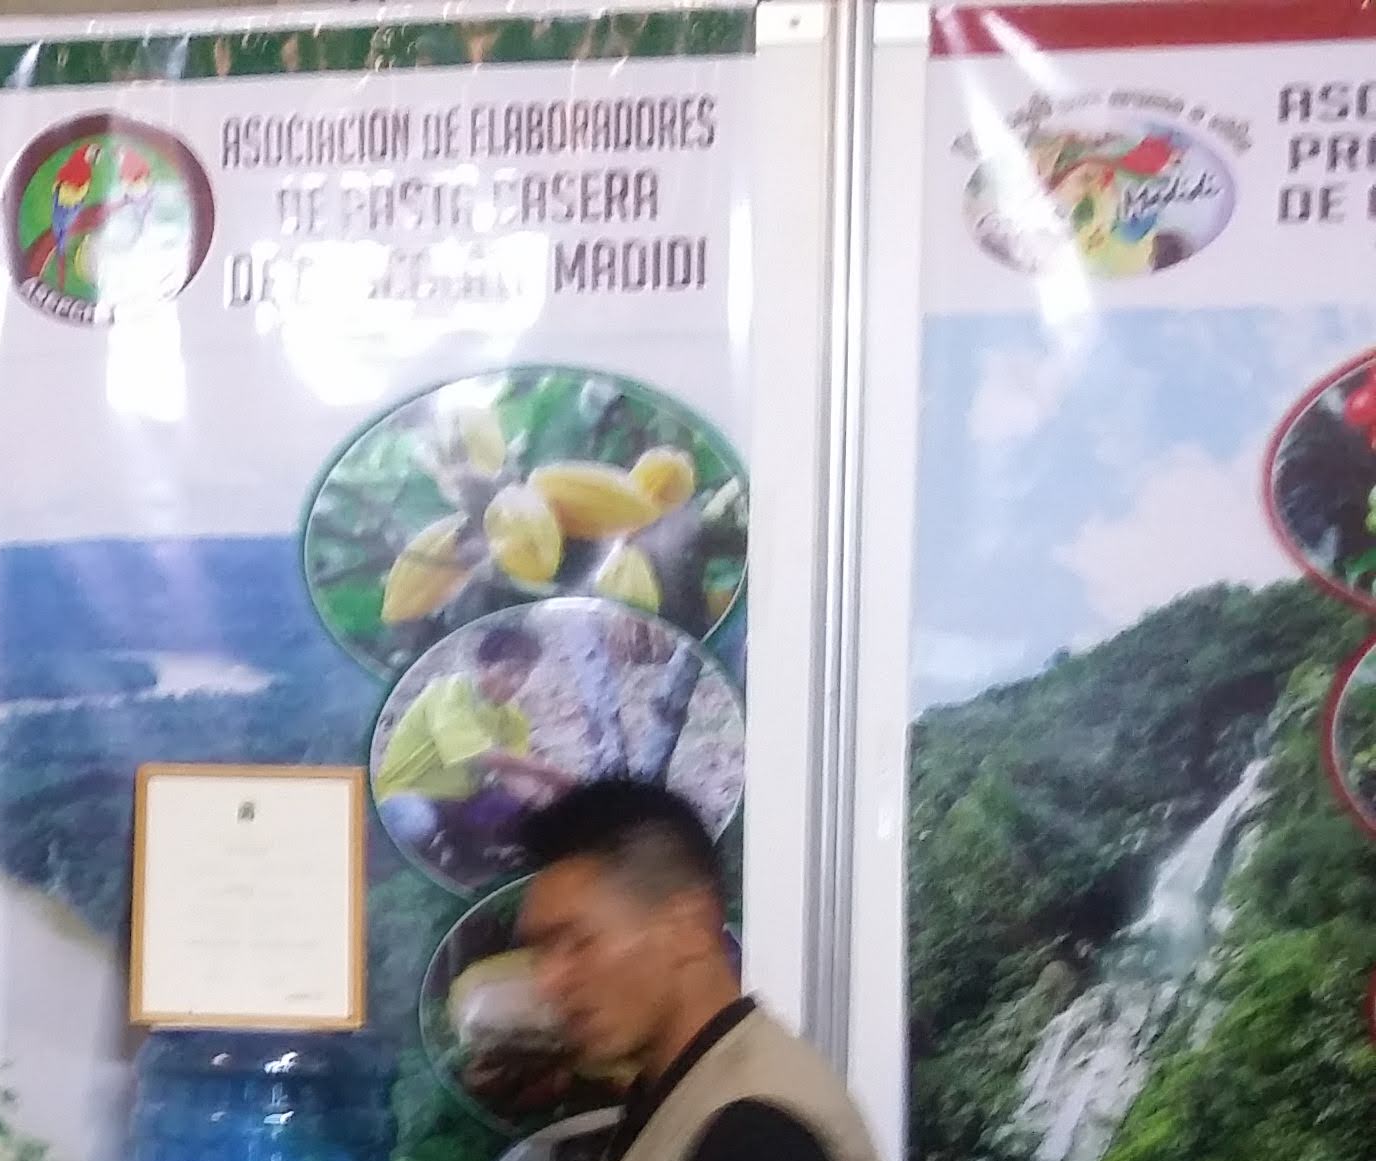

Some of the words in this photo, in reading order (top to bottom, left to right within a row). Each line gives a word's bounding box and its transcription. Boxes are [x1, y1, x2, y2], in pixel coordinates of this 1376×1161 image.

[221, 98, 411, 170] ASOCIACION
[421, 106, 460, 160] DE
[468, 94, 716, 158] ELABORADORES
[1278, 179, 1347, 223] DE
[553, 236, 706, 295] MADIDI
